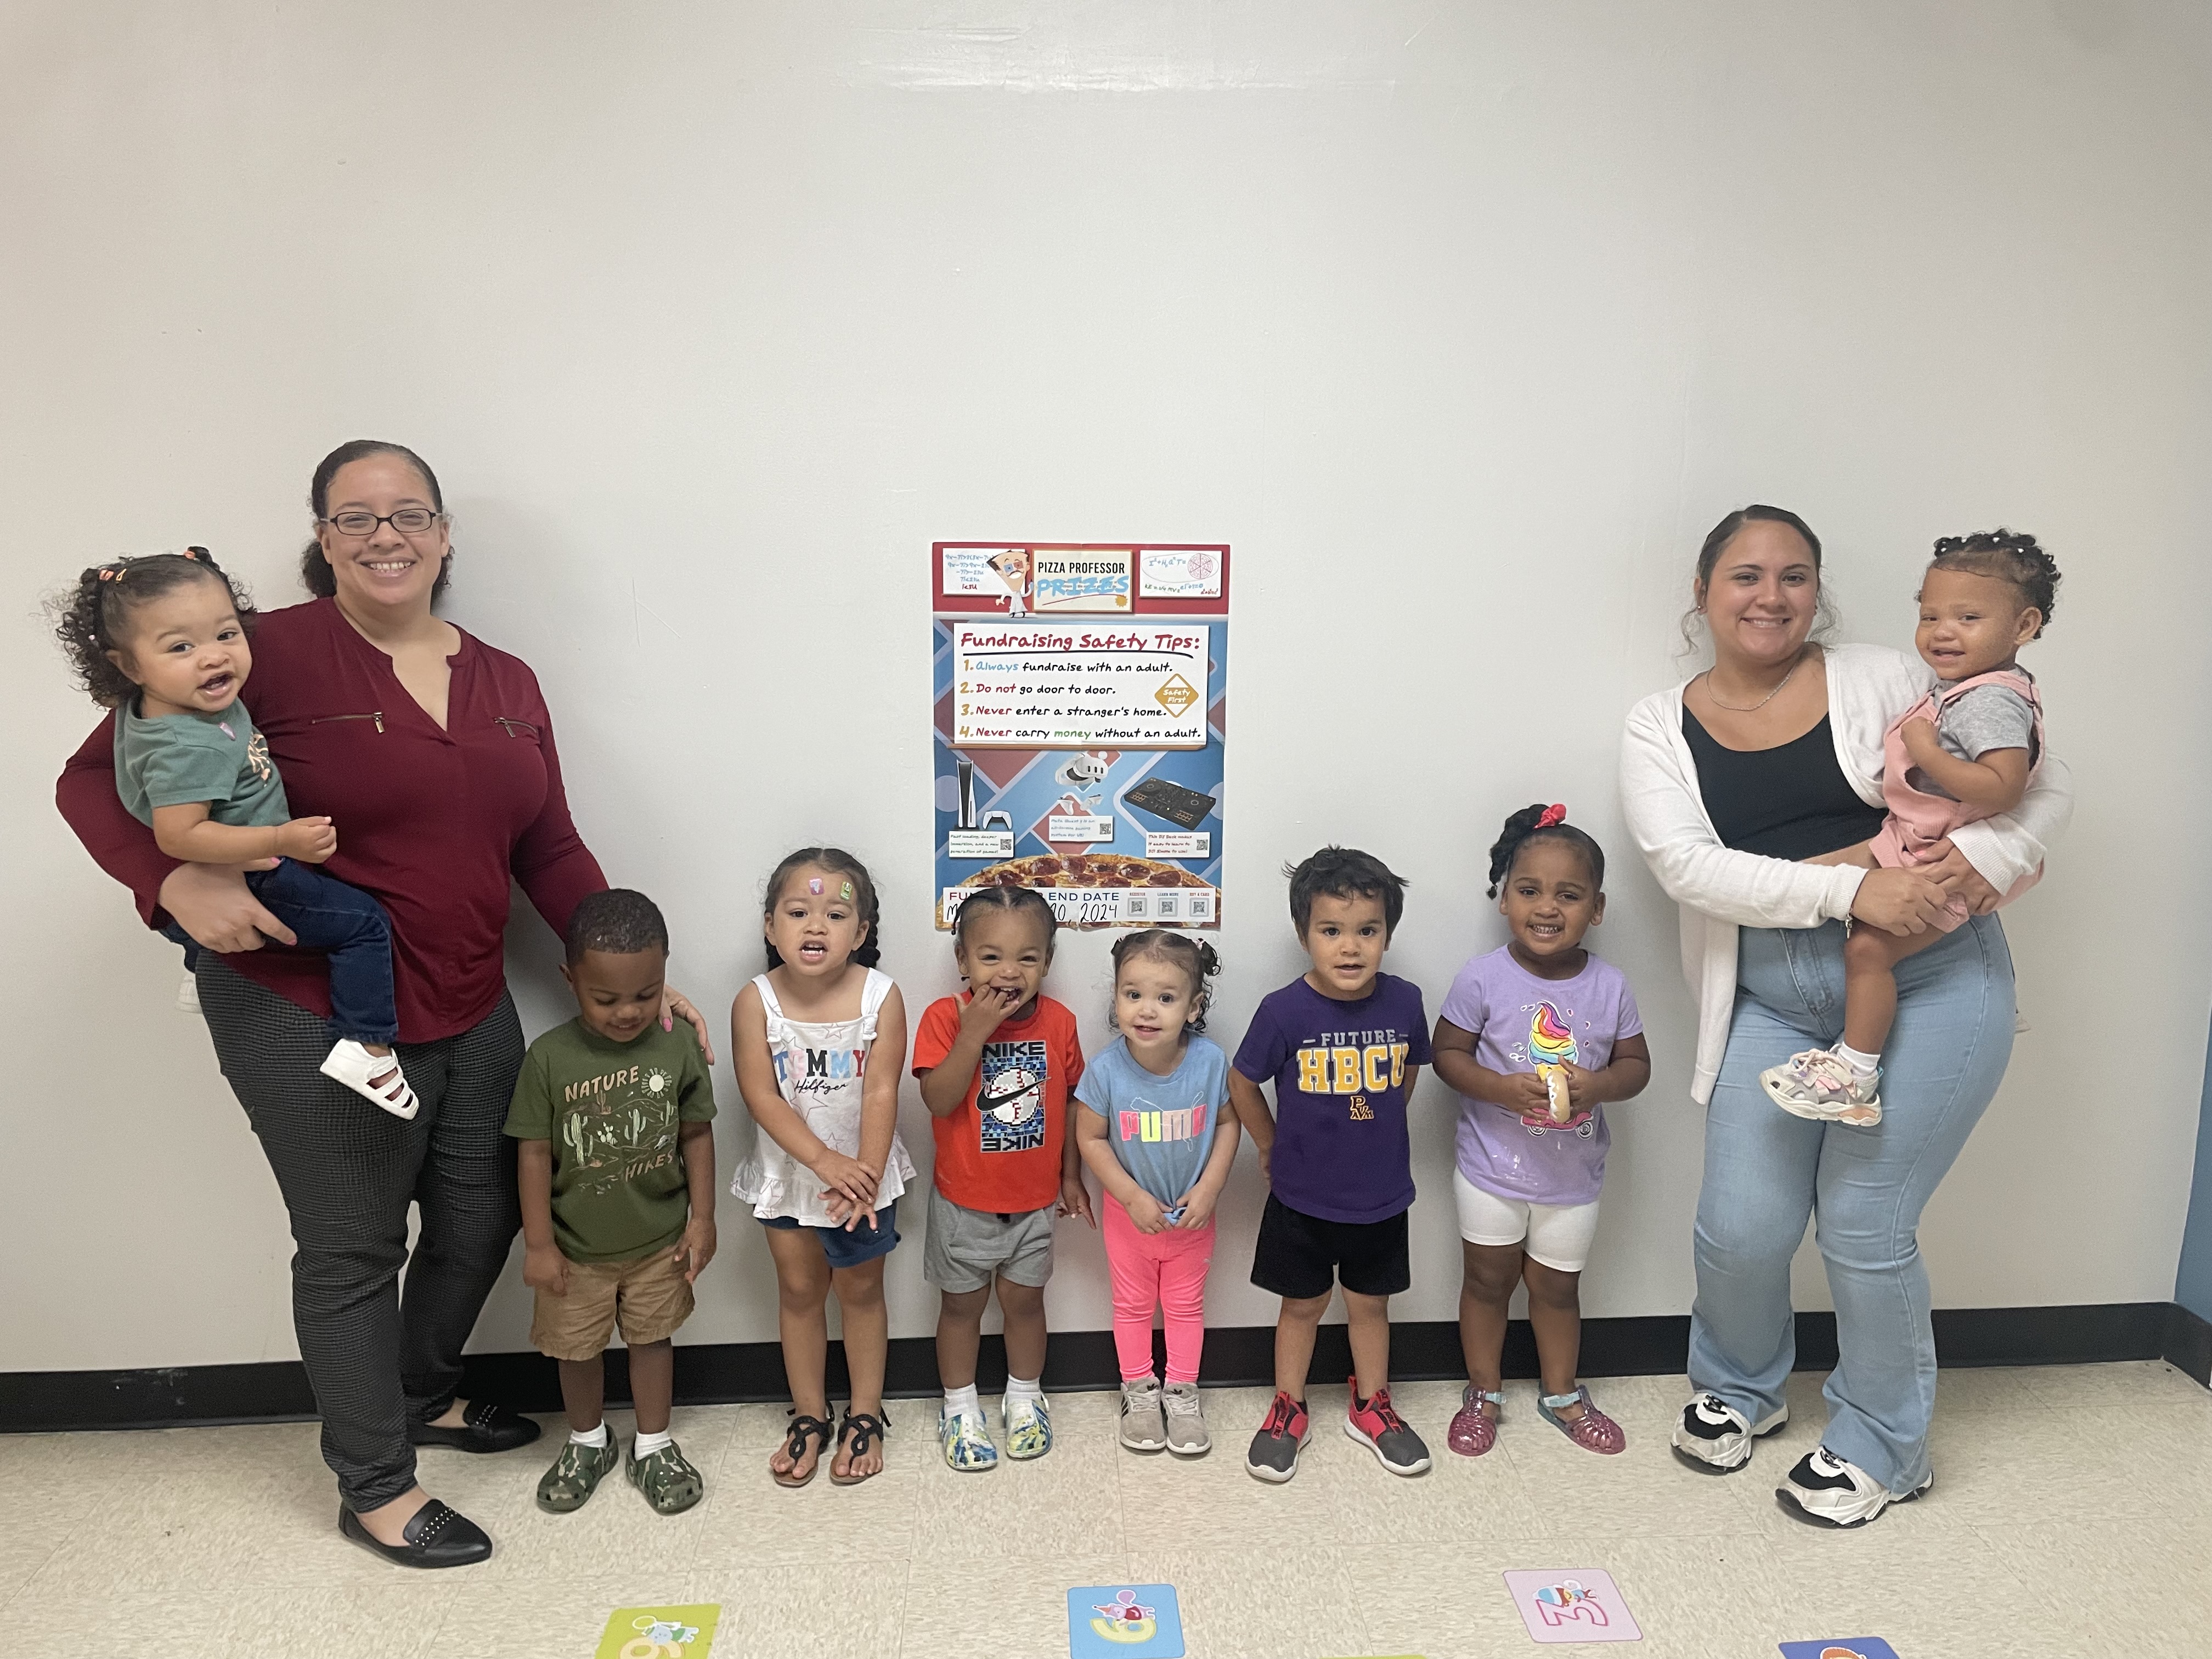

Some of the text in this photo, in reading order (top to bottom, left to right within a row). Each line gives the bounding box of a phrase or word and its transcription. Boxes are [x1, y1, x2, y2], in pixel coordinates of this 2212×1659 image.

[1038, 562, 1125, 574] PIZZA PROFESSOR
[1037, 575, 1129, 598] PRIZES
[961, 633, 1200, 651] Fundraising Safety Tips:
[963, 659, 974, 672] 1.
[975, 661, 1019, 673] Always
[1023, 662, 1083, 672] fundraise
[1087, 662, 1111, 672] with
[1136, 662, 1173, 672] adult.
[960, 681, 1116, 695] 2. Do not go door to door.
[1163, 689, 1190, 697] Safety
[961, 703, 974, 716] 3.
[976, 706, 1012, 715] Never
[1015, 706, 1050, 715] enter
[1066, 706, 1130, 718] stranger's
[1133, 708, 1167, 716] home.
[960, 725, 974, 738] 4.
[976, 727, 1012, 737] Never
[1015, 730, 1050, 739] carry
[1054, 730, 1091, 740] money
[1095, 727, 1141, 738] without
[1164, 727, 1201, 738] adult.
[1048, 893, 1120, 901] END DATE
[1080, 903, 1118, 923] 2024
[1321, 1029, 1396, 1047] FUTURE
[982, 1041, 1046, 1058] NIKE
[773, 1048, 865, 1084] TOMMY
[1296, 1042, 1409, 1095] HBCU
[564, 1065, 639, 1103] NATURE
[795, 1078, 848, 1094] Hilfiger
[1119, 1103, 1206, 1142] PUMA
[981, 1133, 1044, 1152] NIKE
[625, 1148, 674, 1182] HIKES
